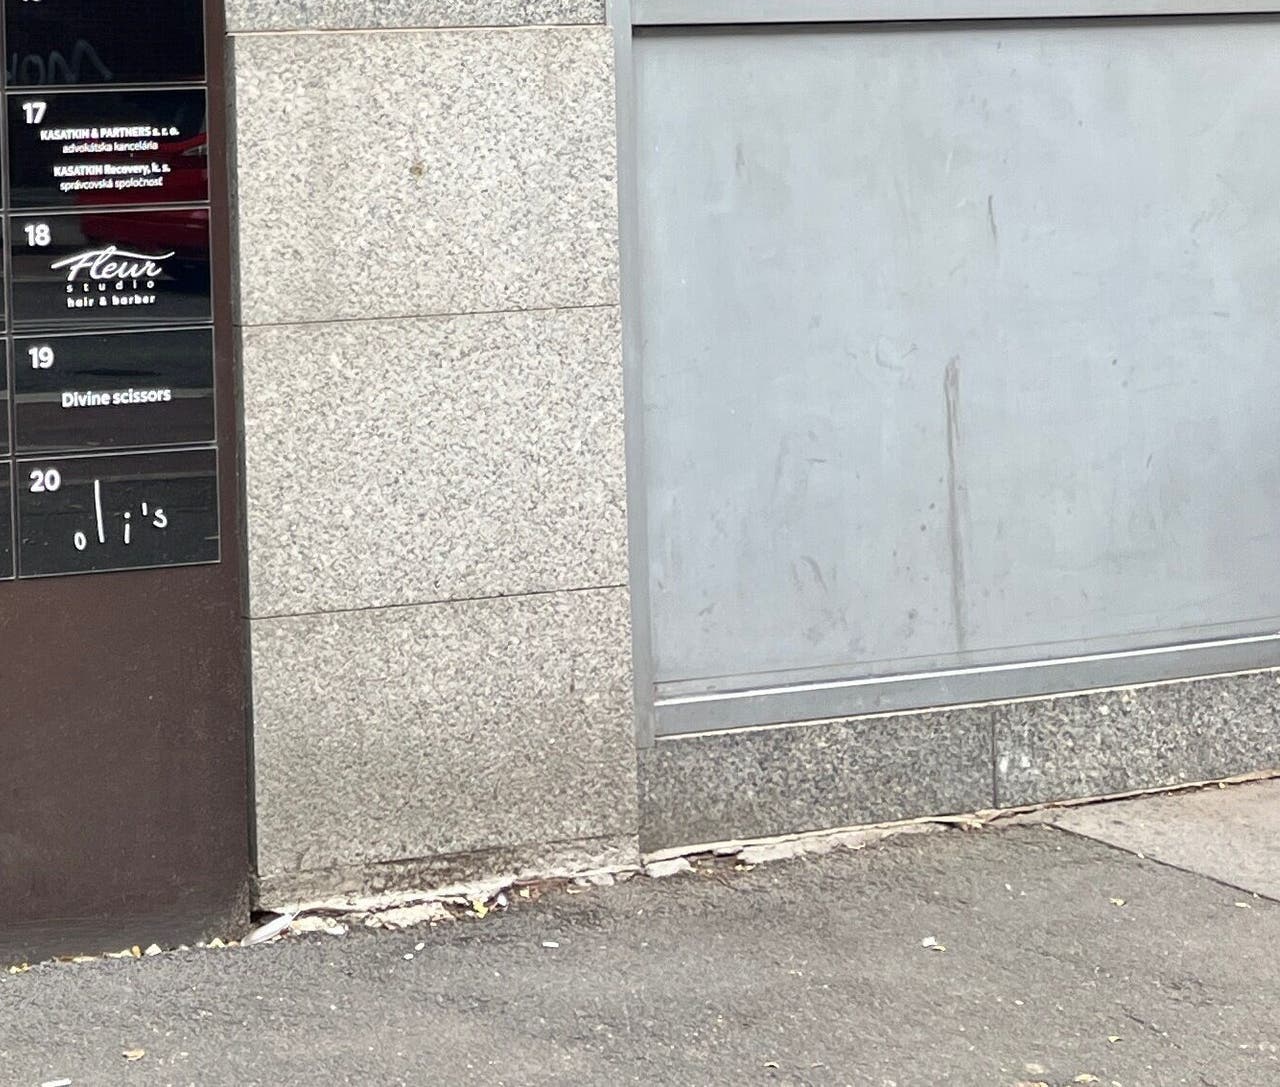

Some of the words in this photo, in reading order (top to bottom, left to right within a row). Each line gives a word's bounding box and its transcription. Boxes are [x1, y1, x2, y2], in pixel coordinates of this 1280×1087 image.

[23, 102, 46, 123] 17
[100, 126, 151, 138] PARTNERS
[63, 142, 113, 153] advokátska
[114, 141, 158, 151] kancelária
[104, 164, 151, 176] Recovery,
[25, 224, 51, 246] 18
[51, 246, 174, 282] Fleur
[67, 297, 94, 307] hair
[99, 296, 107, 305] &
[112, 294, 155, 305] barber
[29, 346, 54, 368] 19
[62, 391, 111, 407] Divine
[113, 388, 171, 404] scissors
[30, 469, 61, 492] 20
